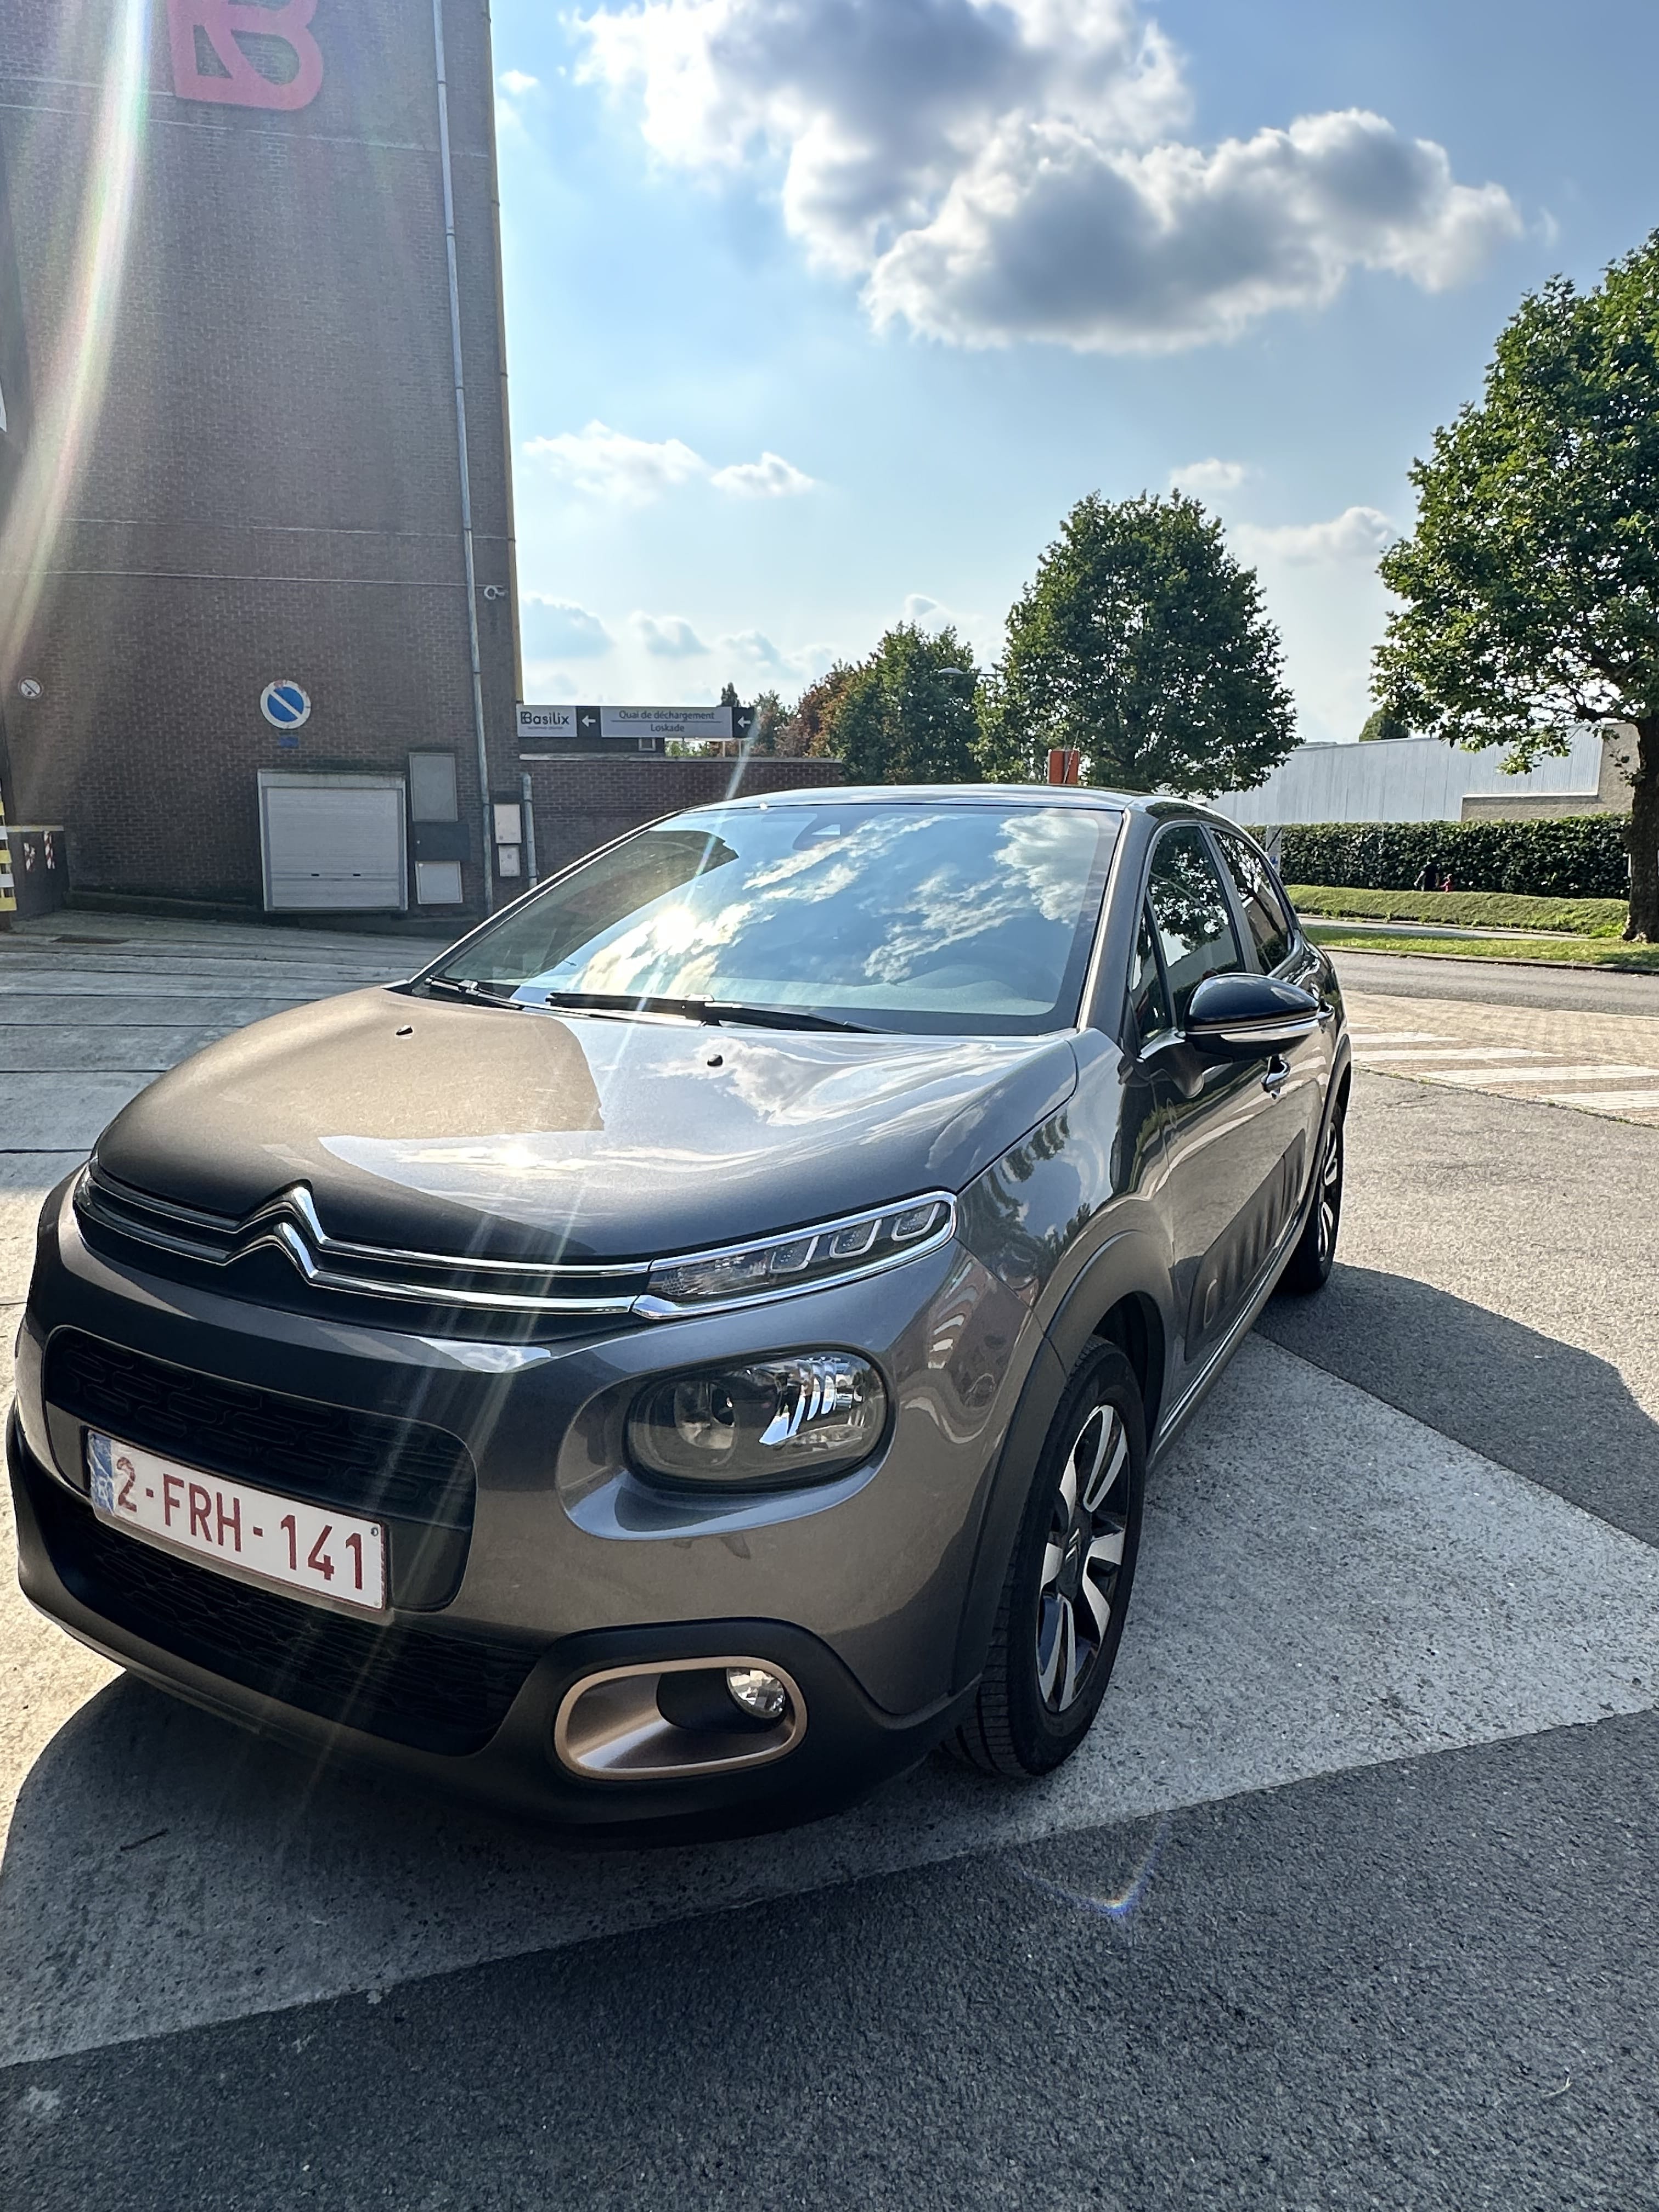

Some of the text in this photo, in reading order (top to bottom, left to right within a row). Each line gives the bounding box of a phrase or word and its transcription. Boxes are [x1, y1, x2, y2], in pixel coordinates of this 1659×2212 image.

[520, 711, 570, 725] Basilix
[619, 710, 639, 719] Quai
[654, 711, 715, 721] déchargement
[651, 724, 685, 732] Loskade
[116, 1457, 363, 1590] 2-FRH-141
